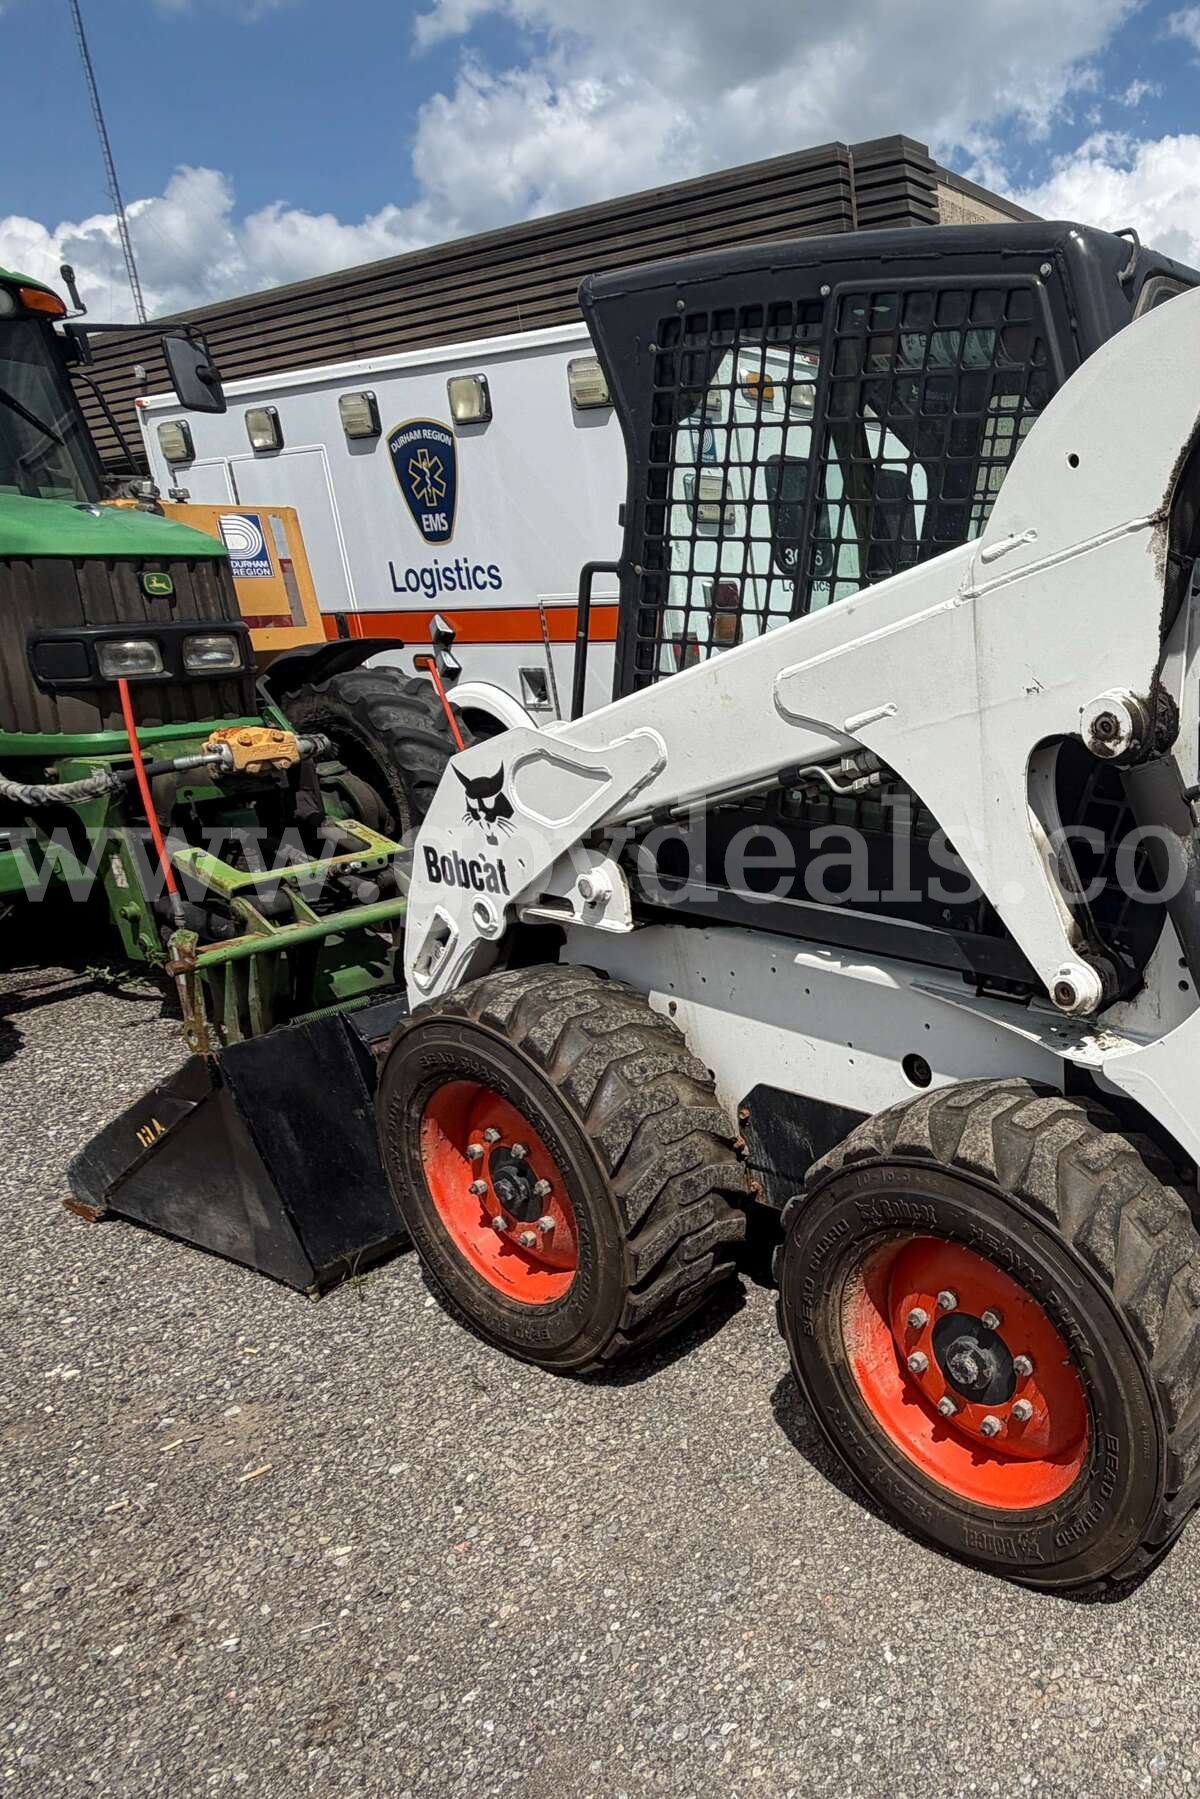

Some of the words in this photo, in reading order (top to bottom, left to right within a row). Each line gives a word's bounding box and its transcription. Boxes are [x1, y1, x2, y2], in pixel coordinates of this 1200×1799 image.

[390, 429, 422, 454] DURHAM
[422, 428, 453, 447] REGION
[421, 512, 449, 533] EMS
[230, 560, 269, 568] DURHAM
[784, 547, 823, 566] 36
[232, 567, 272, 577] REGION
[388, 557, 504, 599] Logistics
[422, 845, 511, 896] Bobcat
